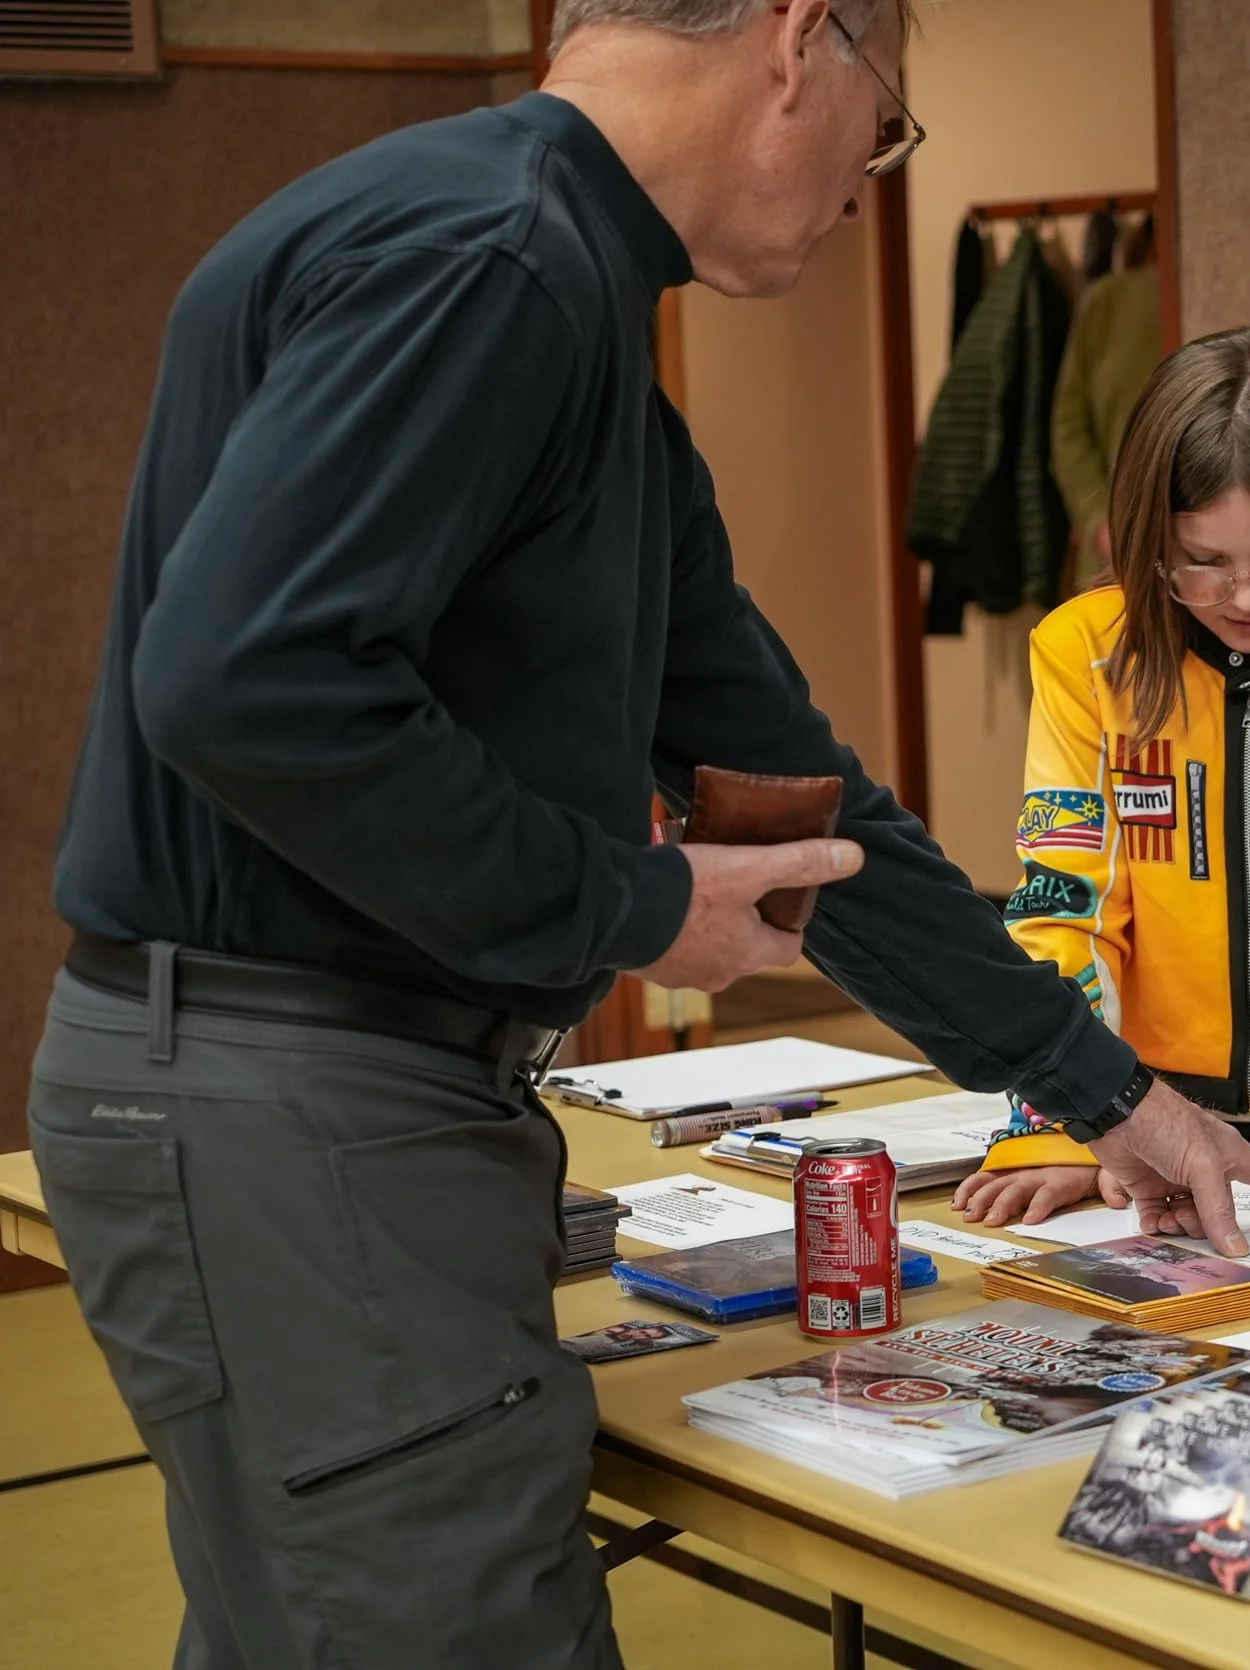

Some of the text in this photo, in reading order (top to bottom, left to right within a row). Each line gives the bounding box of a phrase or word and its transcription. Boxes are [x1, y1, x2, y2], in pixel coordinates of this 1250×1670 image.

[1114, 789, 1168, 809] rrumi
[808, 1160, 835, 1174] Coke
[806, 1203, 847, 1213] Calories 140
[890, 1237, 899, 1322] RECYCLE ME
[965, 1320, 1093, 1356] MOUNT
[949, 1338, 1079, 1376] HELENS
